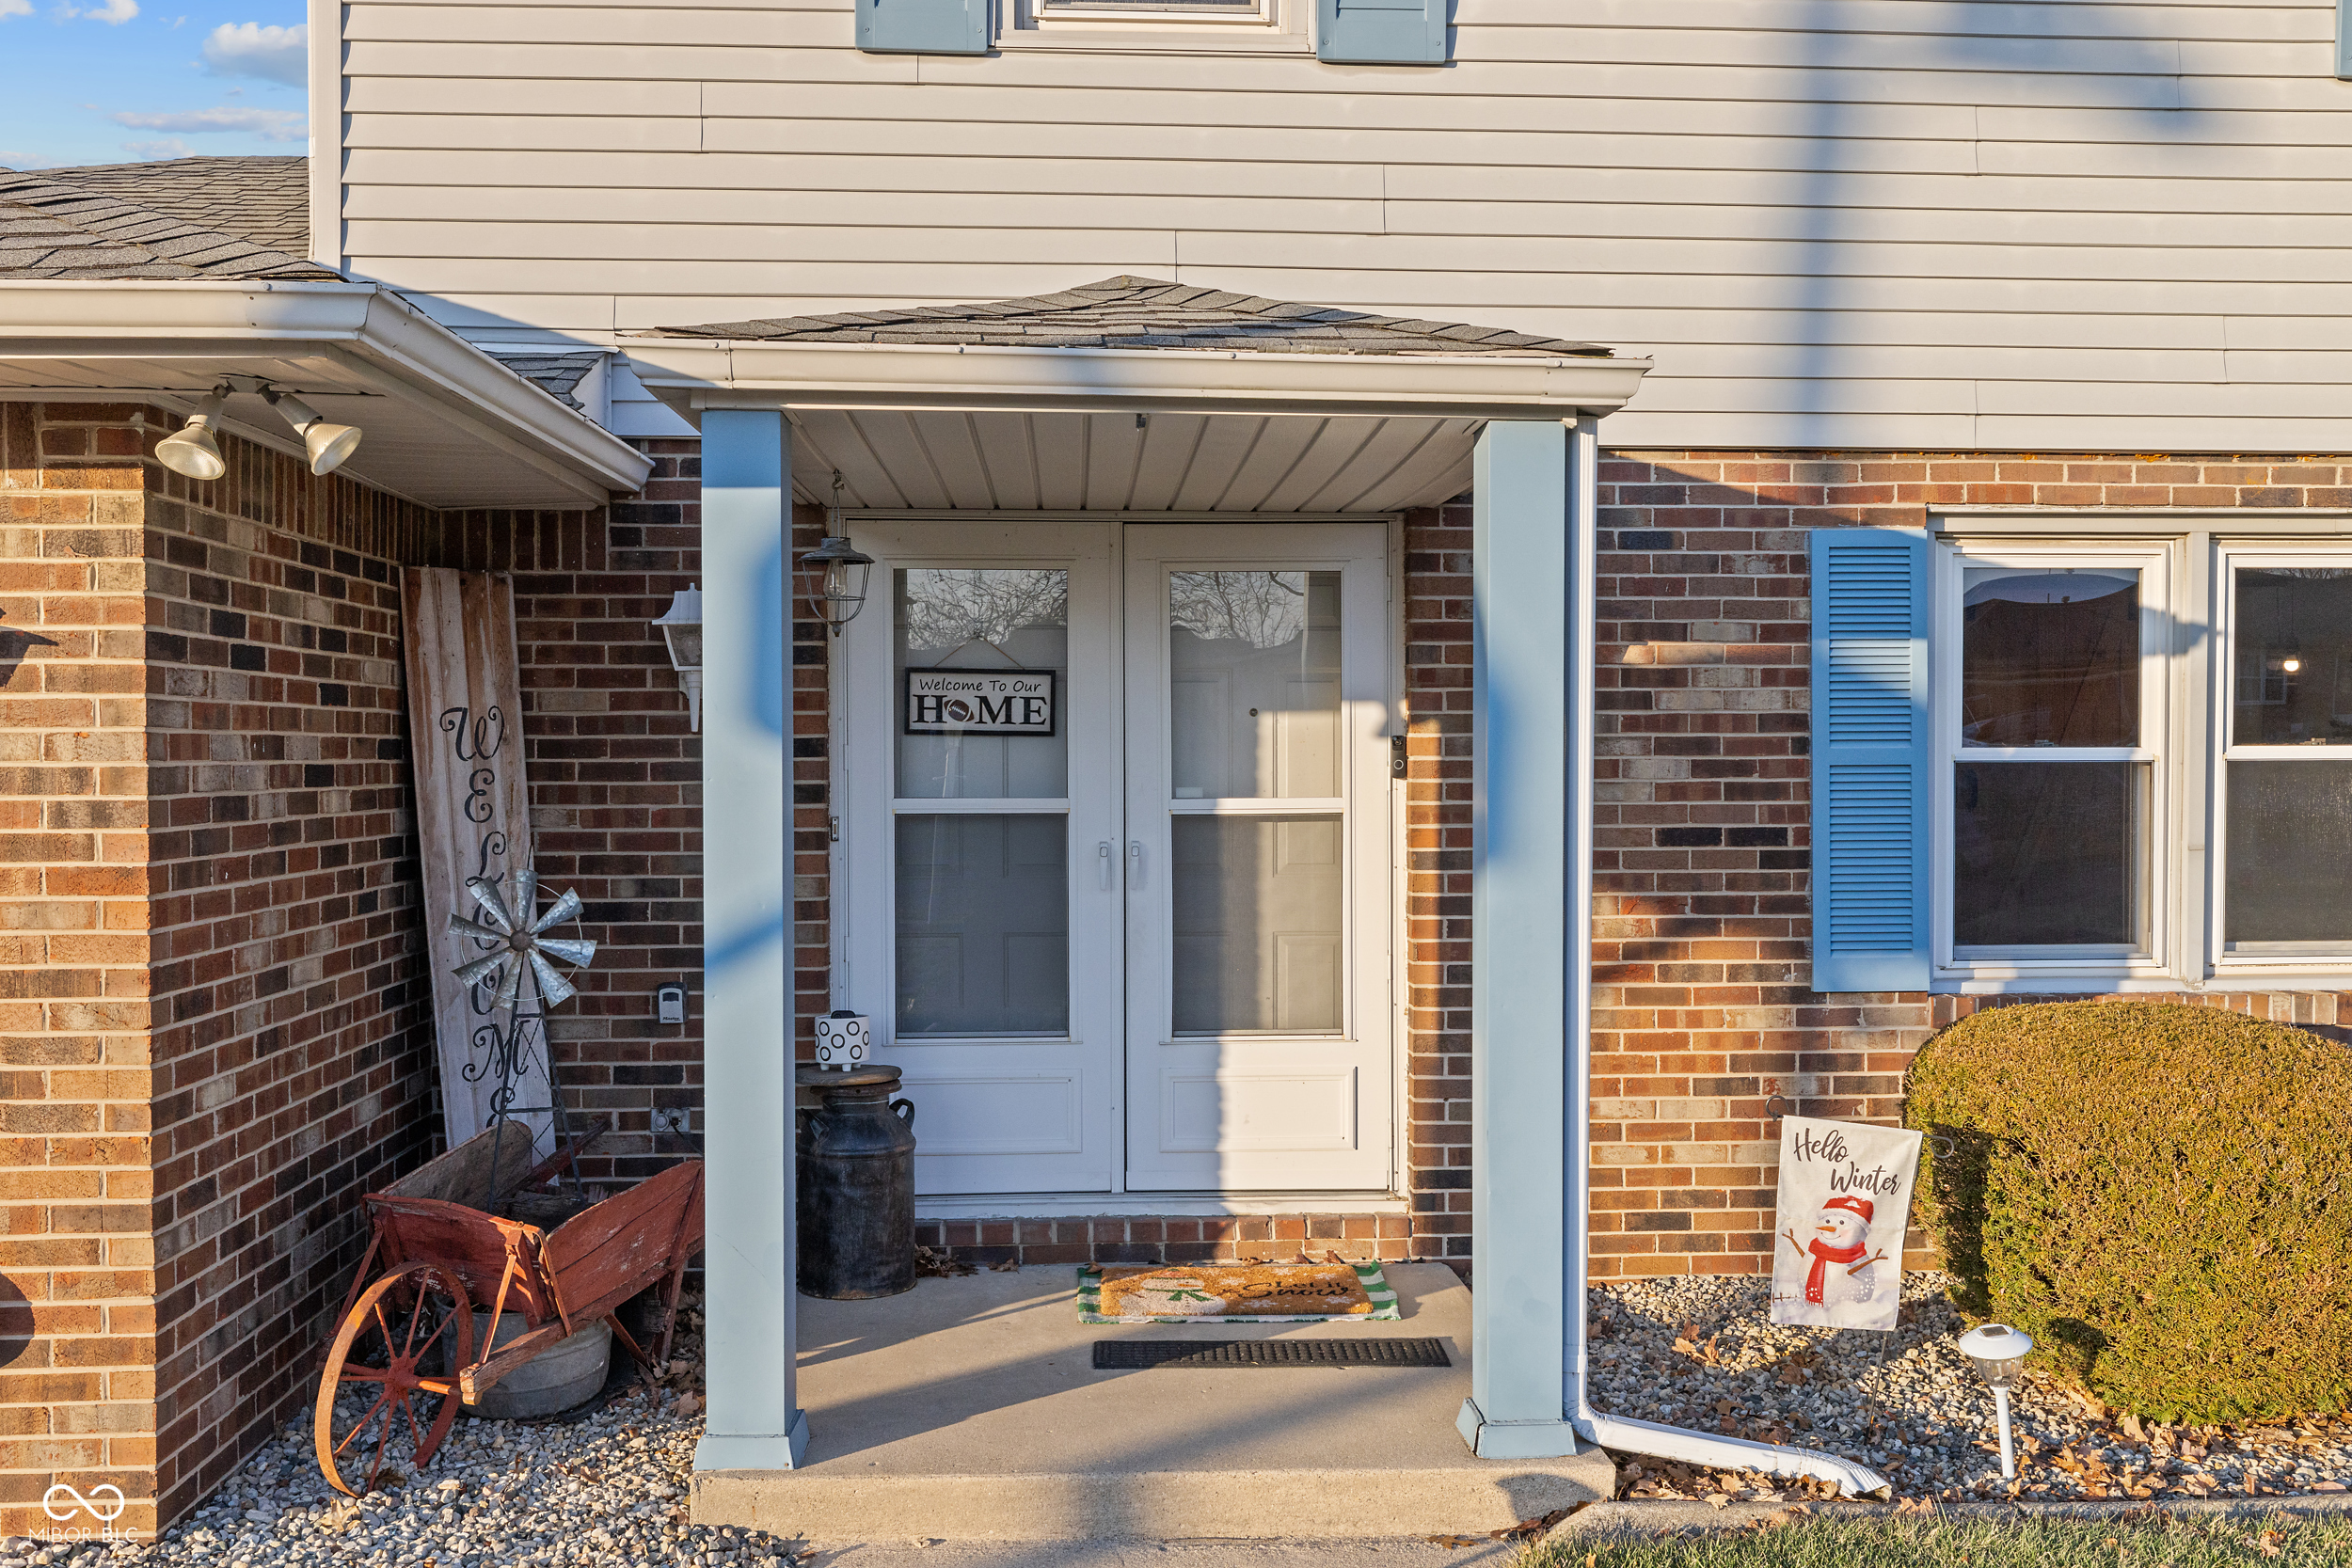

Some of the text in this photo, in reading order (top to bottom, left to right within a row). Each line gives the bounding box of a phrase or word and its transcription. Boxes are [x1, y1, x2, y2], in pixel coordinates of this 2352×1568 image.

[919, 677, 1041, 692] Welcome To Our
[1793, 1127, 1849, 1163] Hello
[1830, 1161, 1901, 1196] Winter
[1238, 1282, 1353, 1298] Snow
